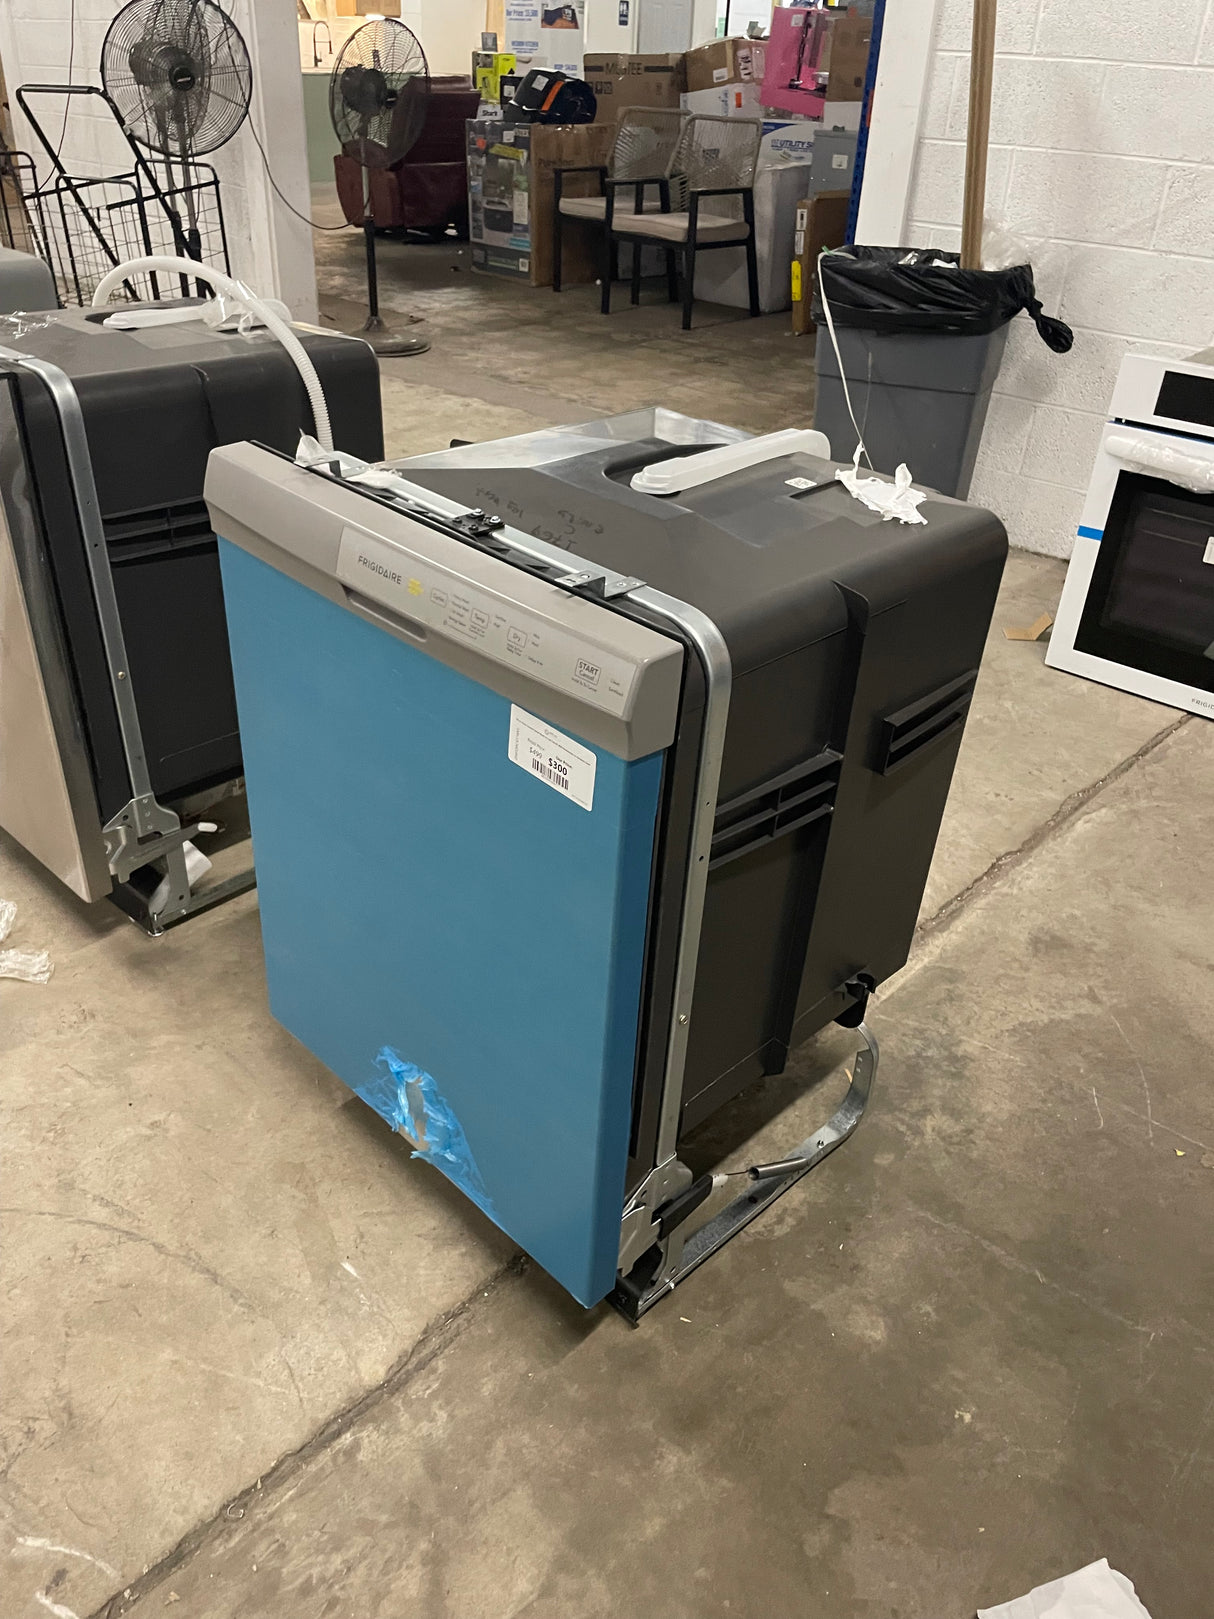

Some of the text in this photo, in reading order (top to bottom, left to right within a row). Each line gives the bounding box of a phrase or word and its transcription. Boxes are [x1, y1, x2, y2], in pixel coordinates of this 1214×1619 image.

[358, 555, 402, 585] FRIGIDAIRE
[579, 661, 599, 676] START
[579, 669, 595, 681] Cancel
[548, 757, 568, 776] $300
